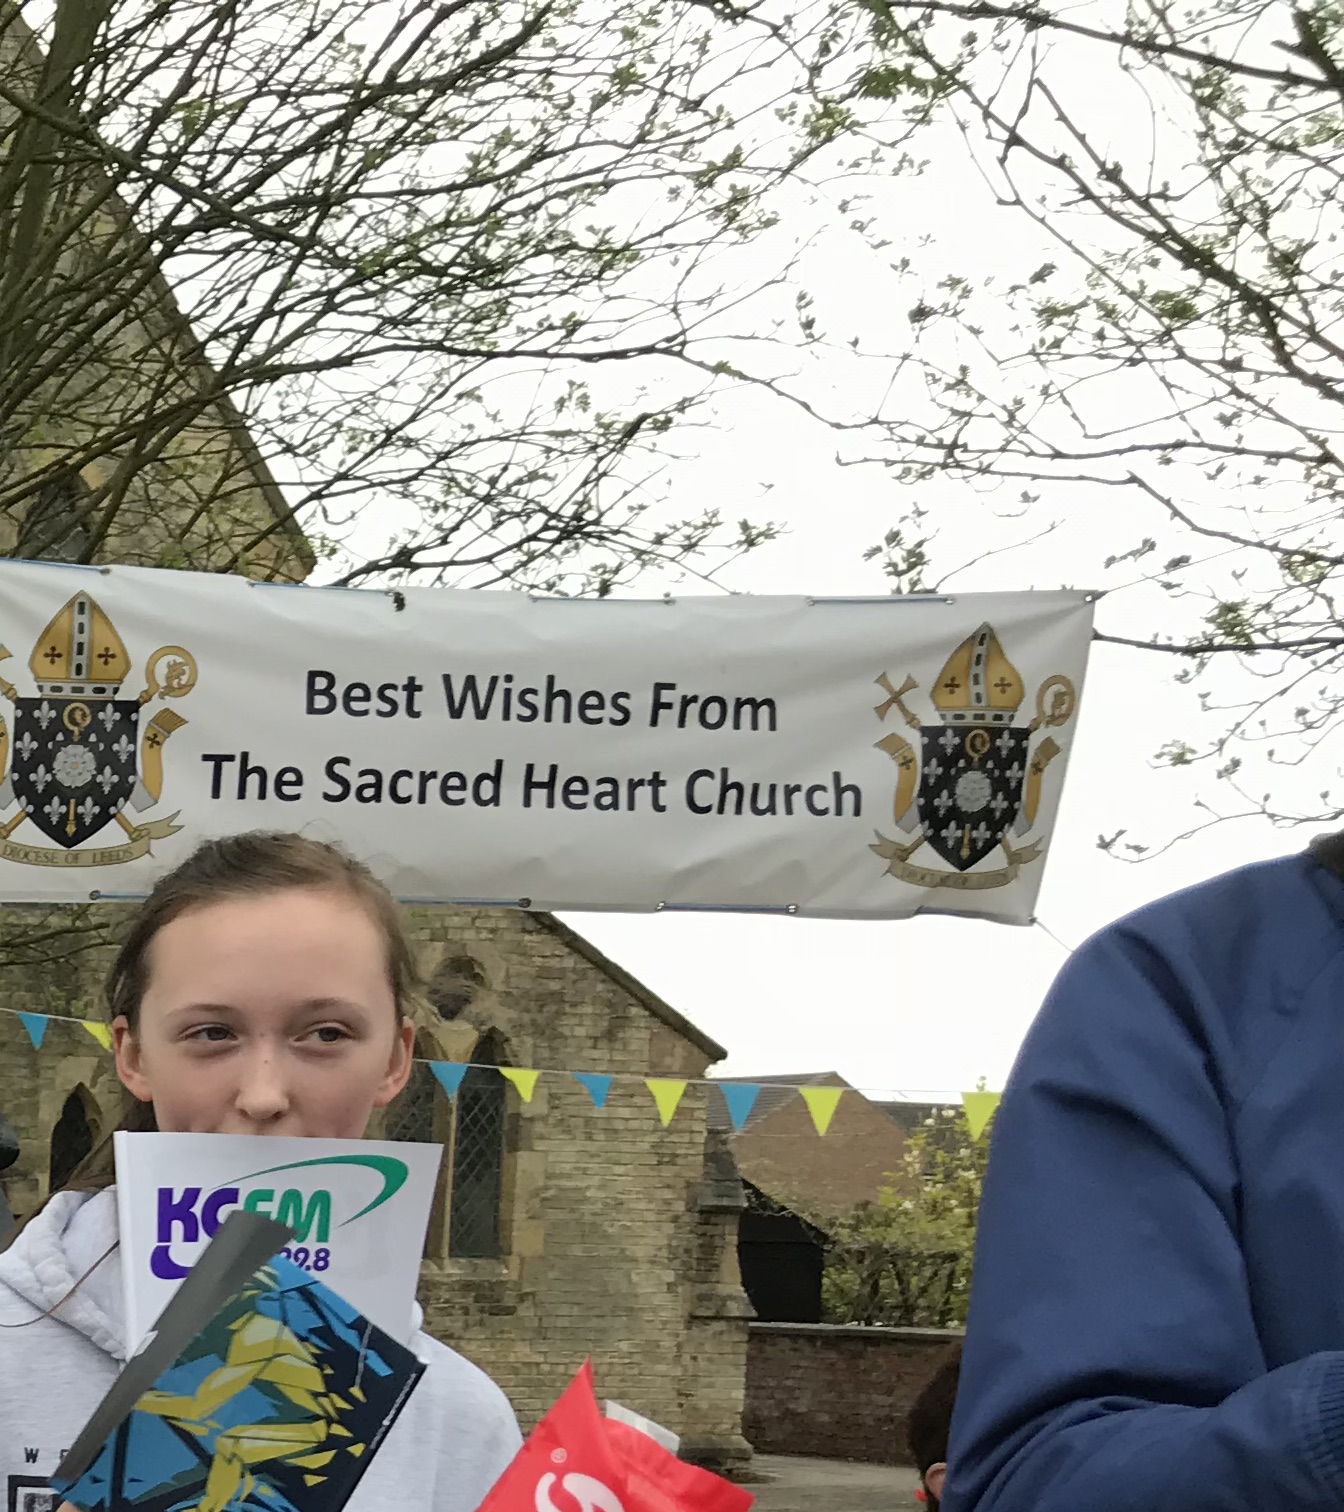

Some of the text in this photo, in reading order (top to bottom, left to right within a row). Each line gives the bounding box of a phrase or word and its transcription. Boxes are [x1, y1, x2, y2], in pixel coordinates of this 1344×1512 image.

[304, 667, 780, 733] Best Wishes From
[200, 751, 866, 819] The Sacred Heart Church
[65, 853, 81, 865] OF
